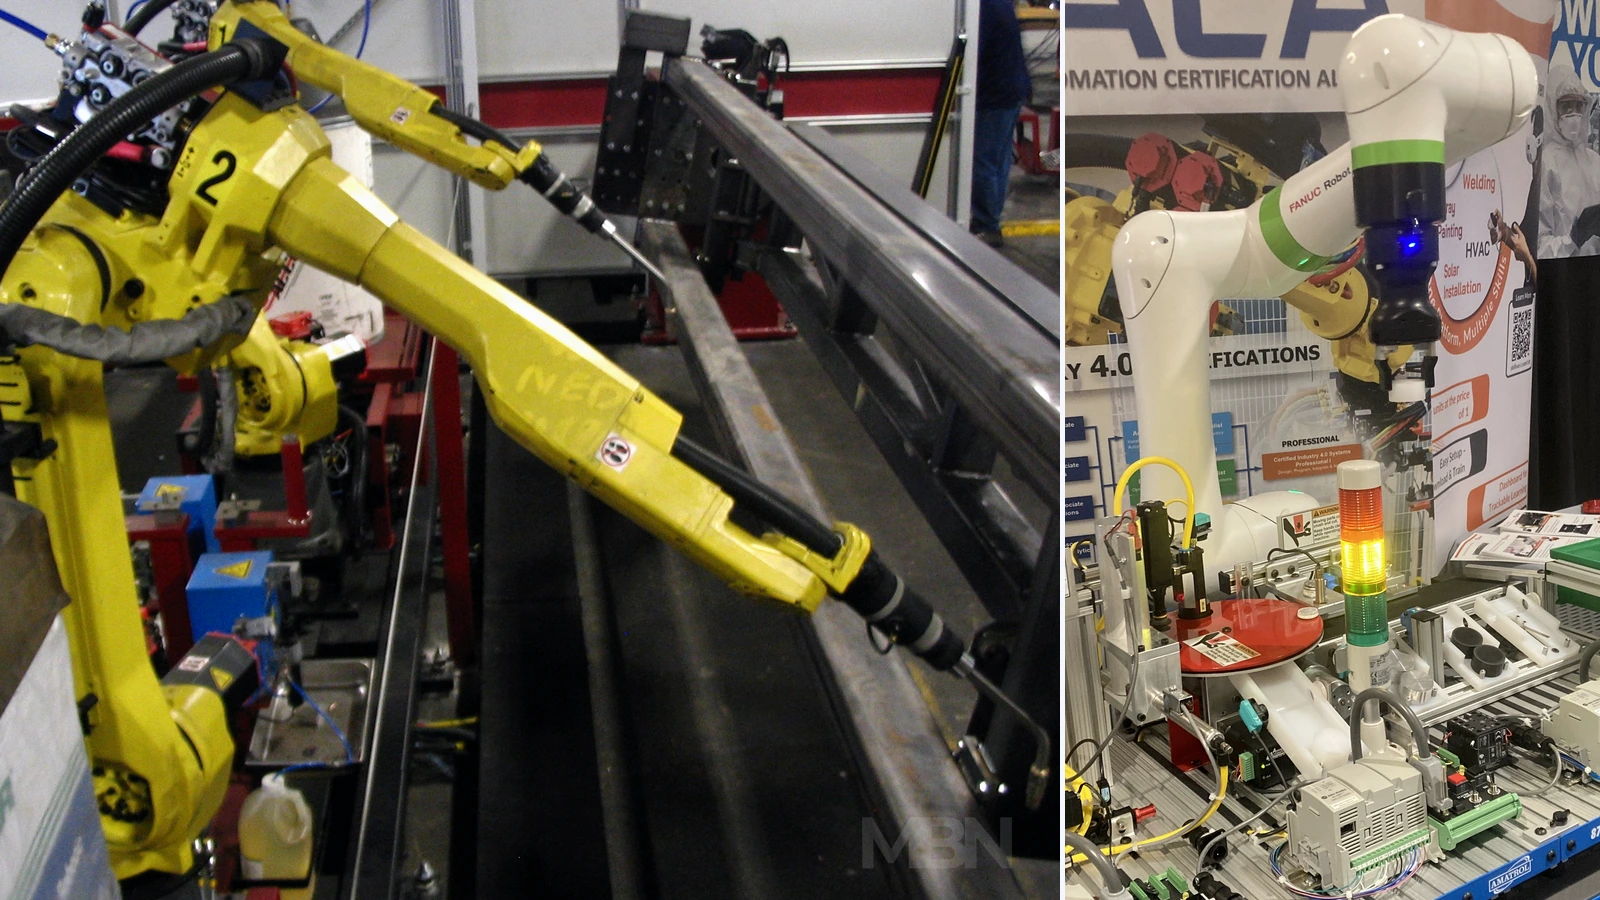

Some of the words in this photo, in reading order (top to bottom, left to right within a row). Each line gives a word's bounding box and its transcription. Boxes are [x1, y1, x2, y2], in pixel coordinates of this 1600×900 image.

[1164, 69, 1310, 88] CERTIFICATION
[195, 150, 237, 207] 2
[1462, 173, 1496, 194] Welding
[1289, 186, 1322, 213] FANUC
[1465, 241, 1490, 258] HVAC
[1444, 263, 1460, 278] Solar
[1444, 280, 1481, 302] Installation
[1463, 301, 1494, 344] Multiple
[1492, 256, 1507, 299] Skills
[1090, 352, 1132, 378] 4.0
[1433, 402, 1444, 415] units
[1457, 391, 1470, 405] price
[1458, 407, 1464, 420] of
[1465, 406, 1469, 417] 1
[1282, 435, 1340, 448] PROFESSIONAL
[1273, 455, 1297, 463] Certified
[1297, 453, 1319, 461] Industry
[1329, 449, 1351, 457] Systems
[1295, 459, 1328, 467] Professional
[1440, 458, 1449, 469] Easy
[1449, 449, 1463, 463] Setup
[1453, 464, 1466, 477] Train
[1499, 471, 1522, 492] Dashboard
[1489, 494, 1510, 512] Trackable
[1510, 484, 1527, 501] Learning
[1490, 863, 1530, 889] AMATROL
